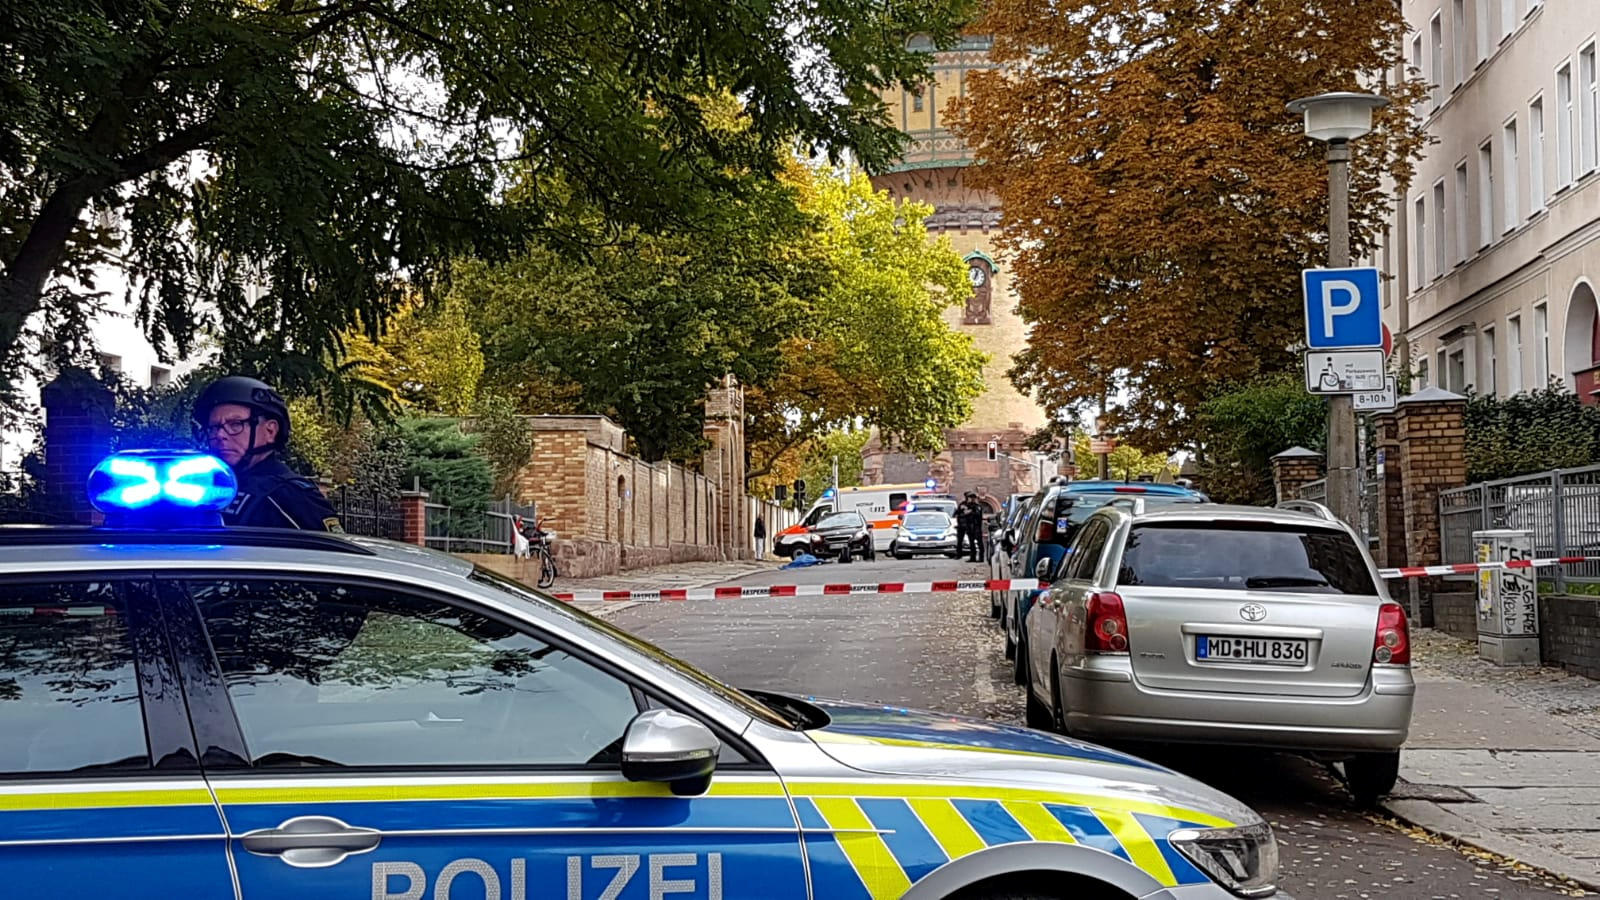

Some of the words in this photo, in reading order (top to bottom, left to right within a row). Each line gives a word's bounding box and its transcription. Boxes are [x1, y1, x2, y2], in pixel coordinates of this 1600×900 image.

[1321, 280, 1360, 337] P
[1208, 639, 1232, 656] MD
[1243, 641, 1267, 658] HU
[1271, 642, 1304, 659] 836
